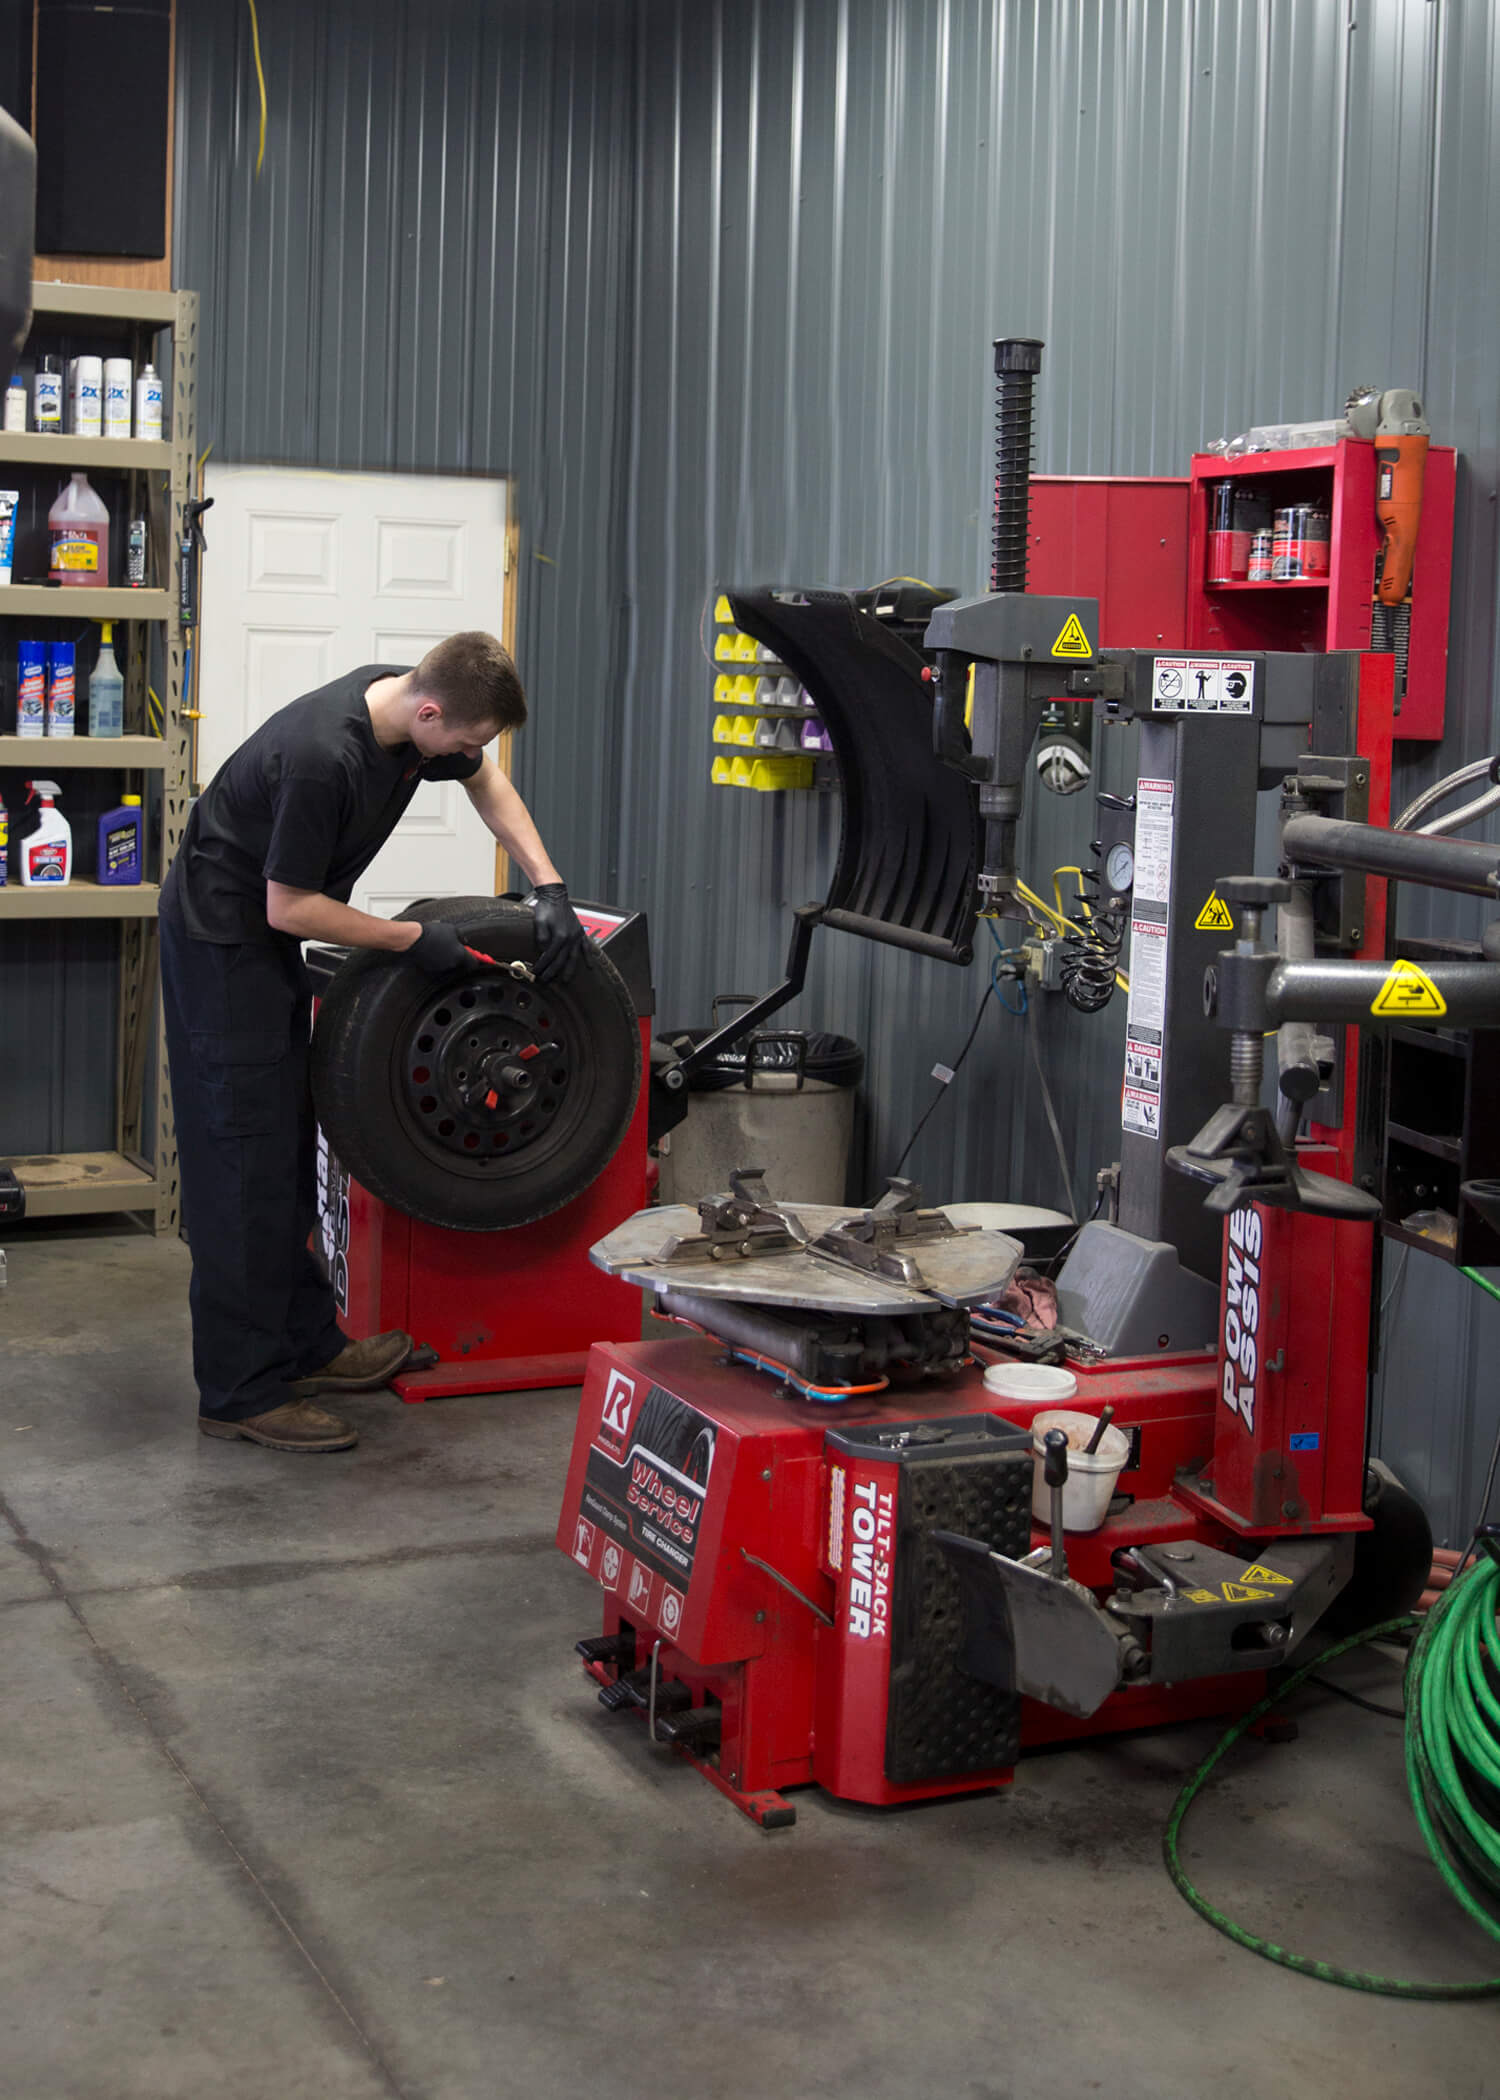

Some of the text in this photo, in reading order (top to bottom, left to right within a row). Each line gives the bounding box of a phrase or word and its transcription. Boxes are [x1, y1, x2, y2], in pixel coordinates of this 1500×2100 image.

[39, 383, 57, 396] 2X
[81, 385, 98, 398] 2X
[107, 387, 125, 400] 2X
[1139, 924, 1166, 936] CAUTION
[1133, 1043, 1159, 1057] DANGER
[1223, 1208, 1246, 1415] POWE
[1239, 1208, 1262, 1433] ASSIS
[626, 1483, 694, 1544] Service
[632, 1458, 700, 1524] Wheel
[641, 1525, 690, 1567] TIRE CHANGER
[849, 1480, 878, 1640] TOWER
[872, 1492, 892, 1637] TILT-BACK
